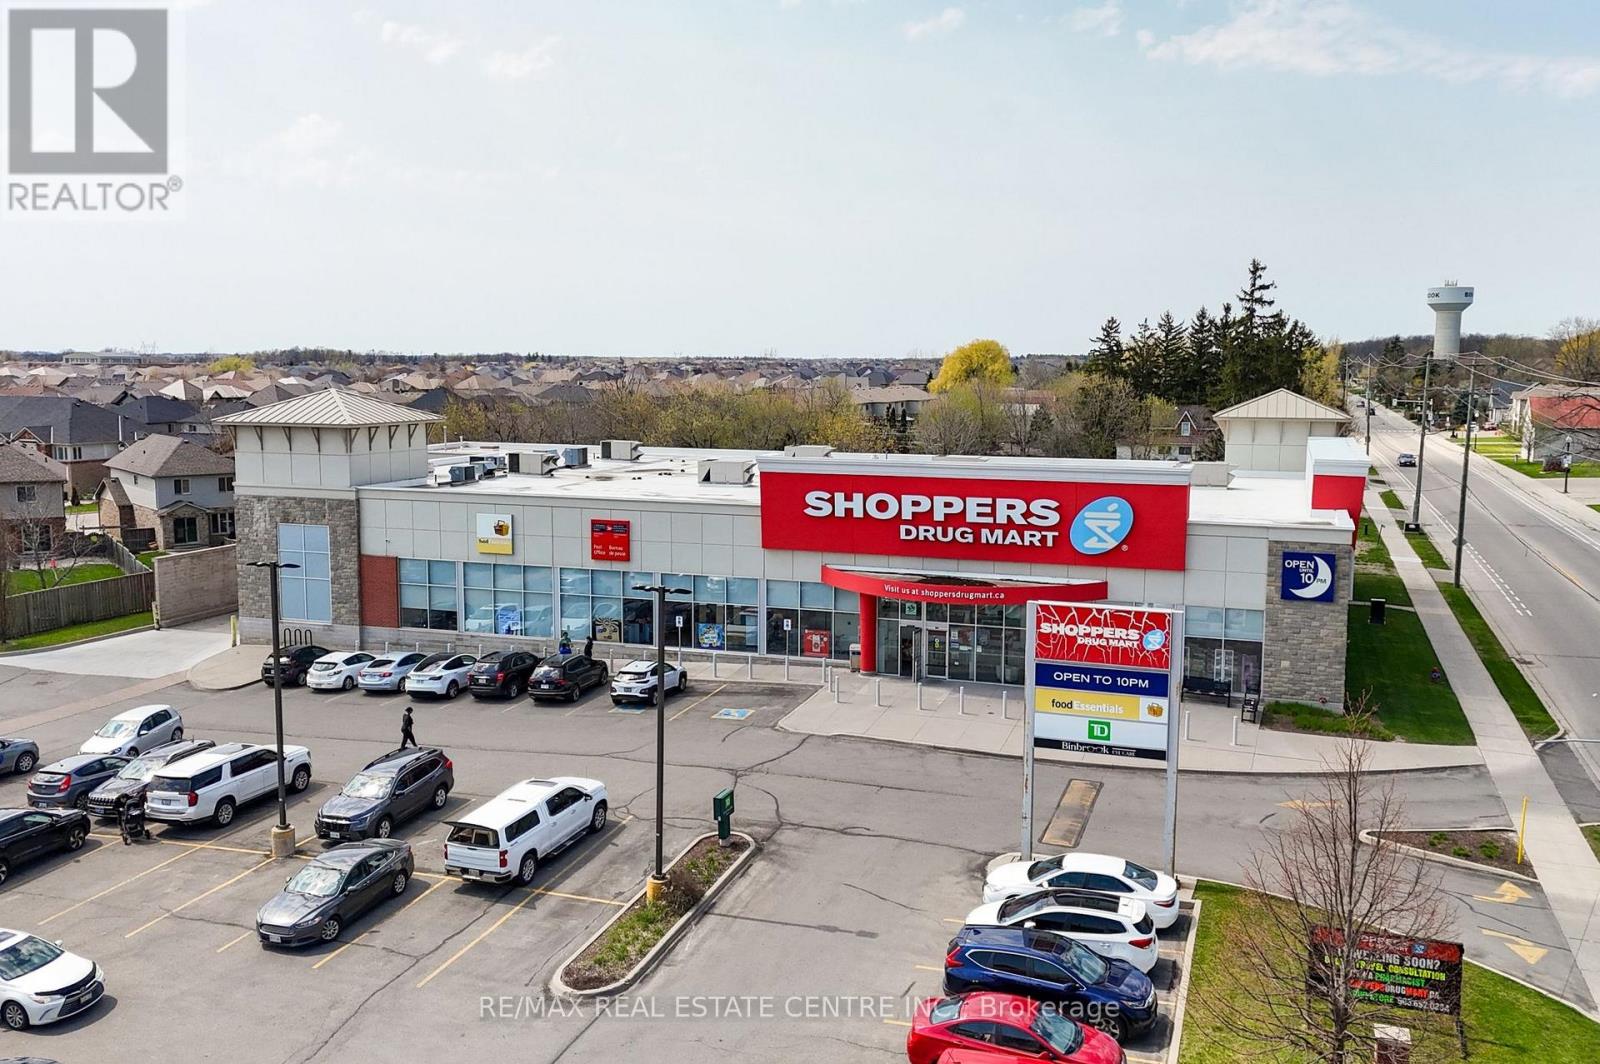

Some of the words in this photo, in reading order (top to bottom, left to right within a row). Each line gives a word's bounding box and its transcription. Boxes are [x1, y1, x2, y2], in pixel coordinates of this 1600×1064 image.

[803, 490, 1061, 527] SHOPPERS
[900, 524, 974, 543] DRUG
[980, 528, 1059, 547] MART
[1285, 559, 1314, 569] OPEN
[1300, 573, 1314, 584] 10
[884, 584, 900, 593] Visit
[911, 587, 919, 595] at
[920, 588, 1005, 600] shoppersdrugmart.ca
[1040, 622, 1140, 640] SHOPPERS
[1077, 637, 1107, 646] DRUG
[1109, 639, 1139, 648] MART
[1053, 671, 1090, 683] OPEN
[1093, 675, 1112, 685] TO
[1116, 677, 1149, 689] 10PM
[1091, 724, 1109, 737] TD
[1061, 741, 1109, 754] Binbrook
[1403, 955, 1441, 970] SOON?
